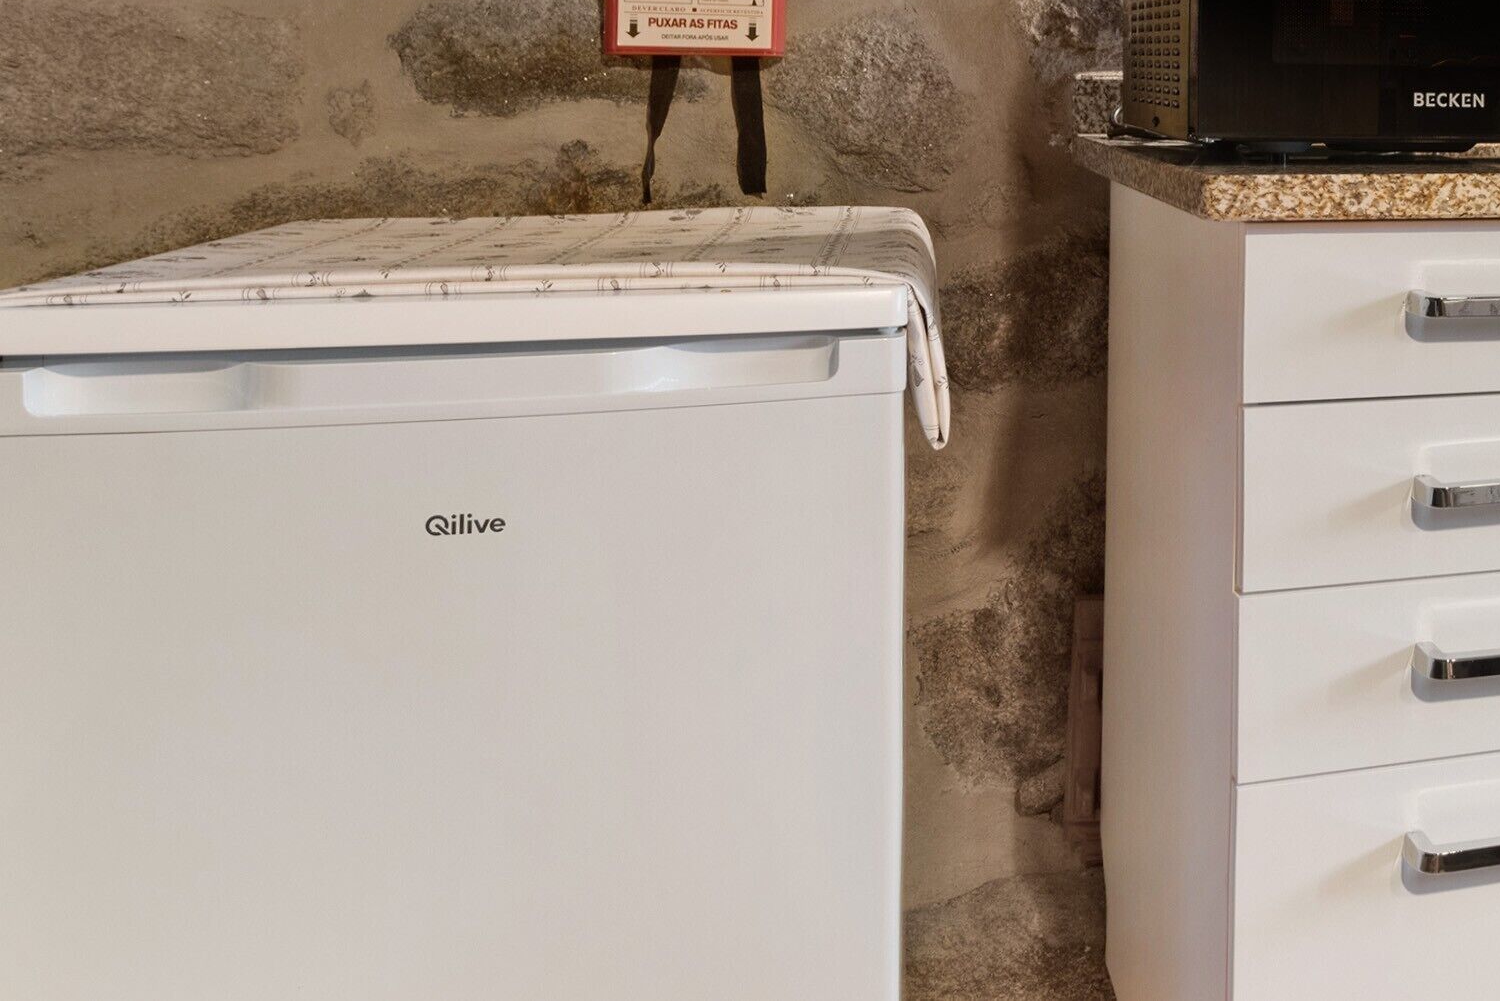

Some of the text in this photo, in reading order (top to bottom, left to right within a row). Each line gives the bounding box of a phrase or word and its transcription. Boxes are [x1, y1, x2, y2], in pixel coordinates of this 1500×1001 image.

[648, 17, 738, 30] PUXAR AS FITAS
[1413, 92, 1485, 108] BECKEN
[425, 513, 507, 536] Qilive
